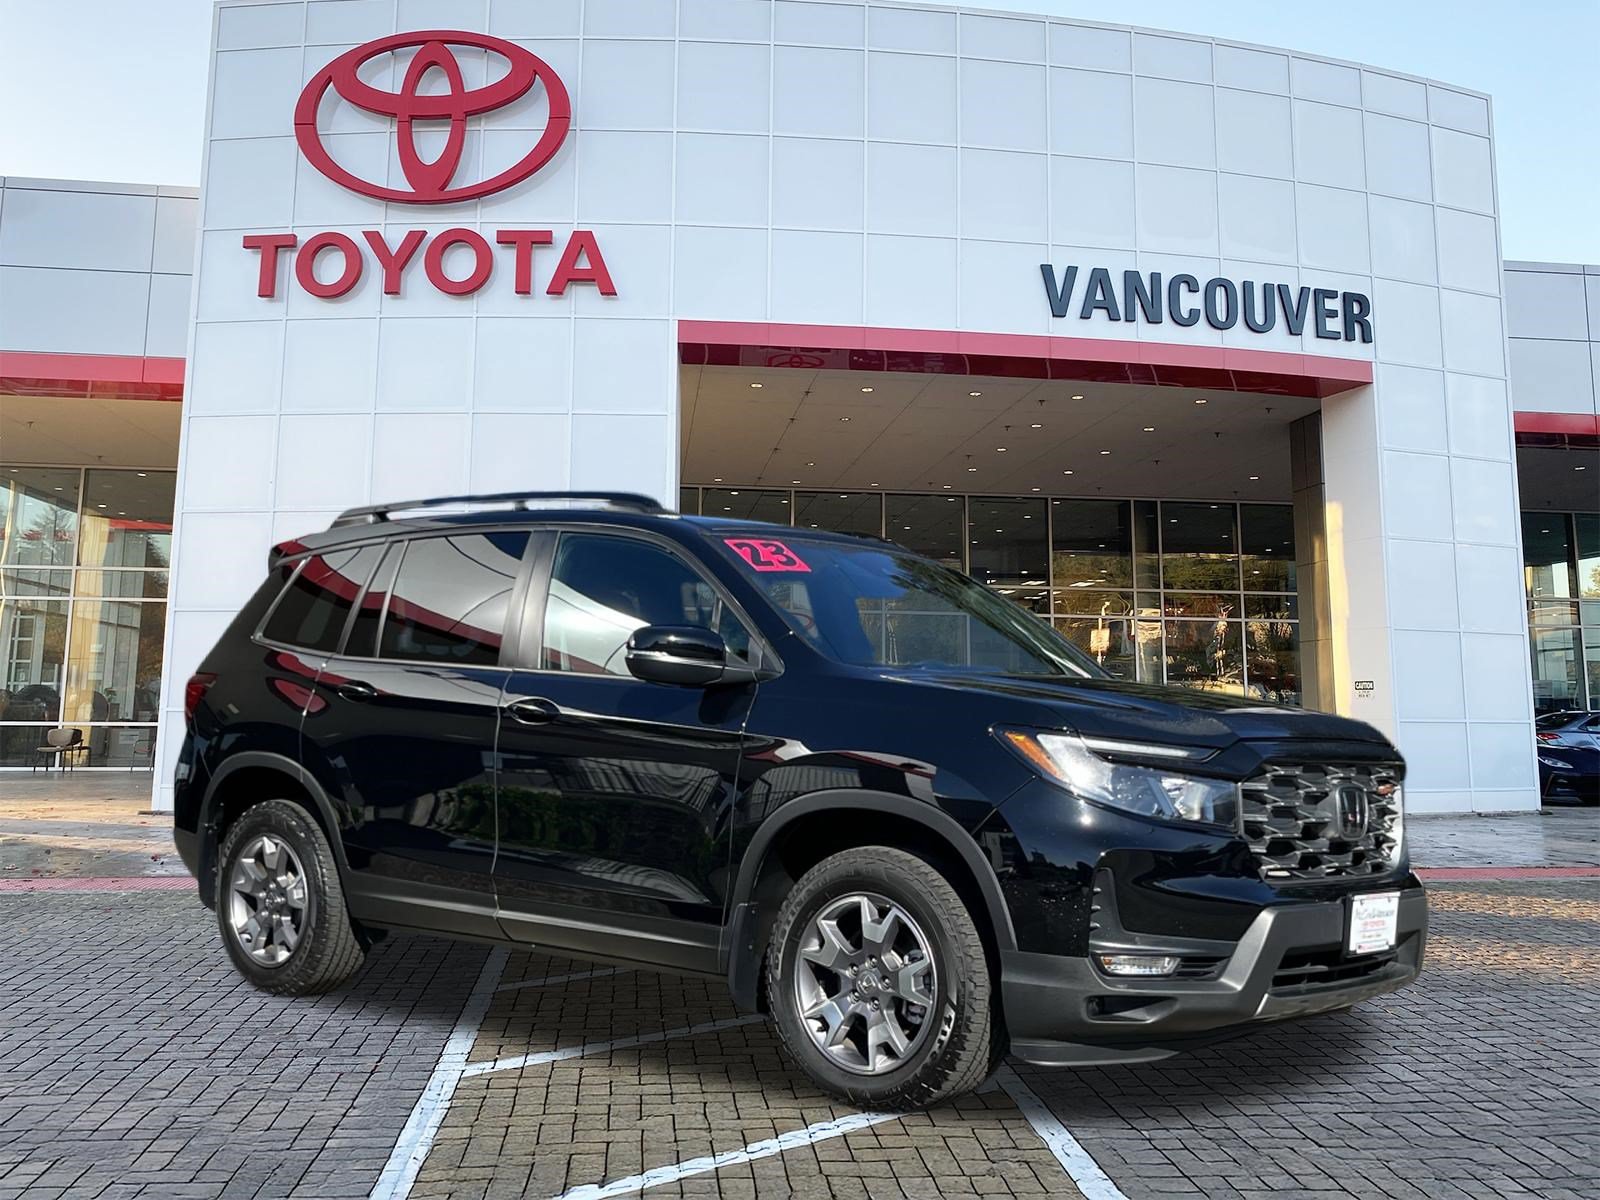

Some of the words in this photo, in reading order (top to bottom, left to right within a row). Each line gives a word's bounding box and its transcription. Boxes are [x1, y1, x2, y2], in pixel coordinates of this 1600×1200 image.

[243, 228, 617, 299] TOYOTA
[1040, 264, 1372, 343] VANCOUVER
[733, 542, 797, 567] 23
